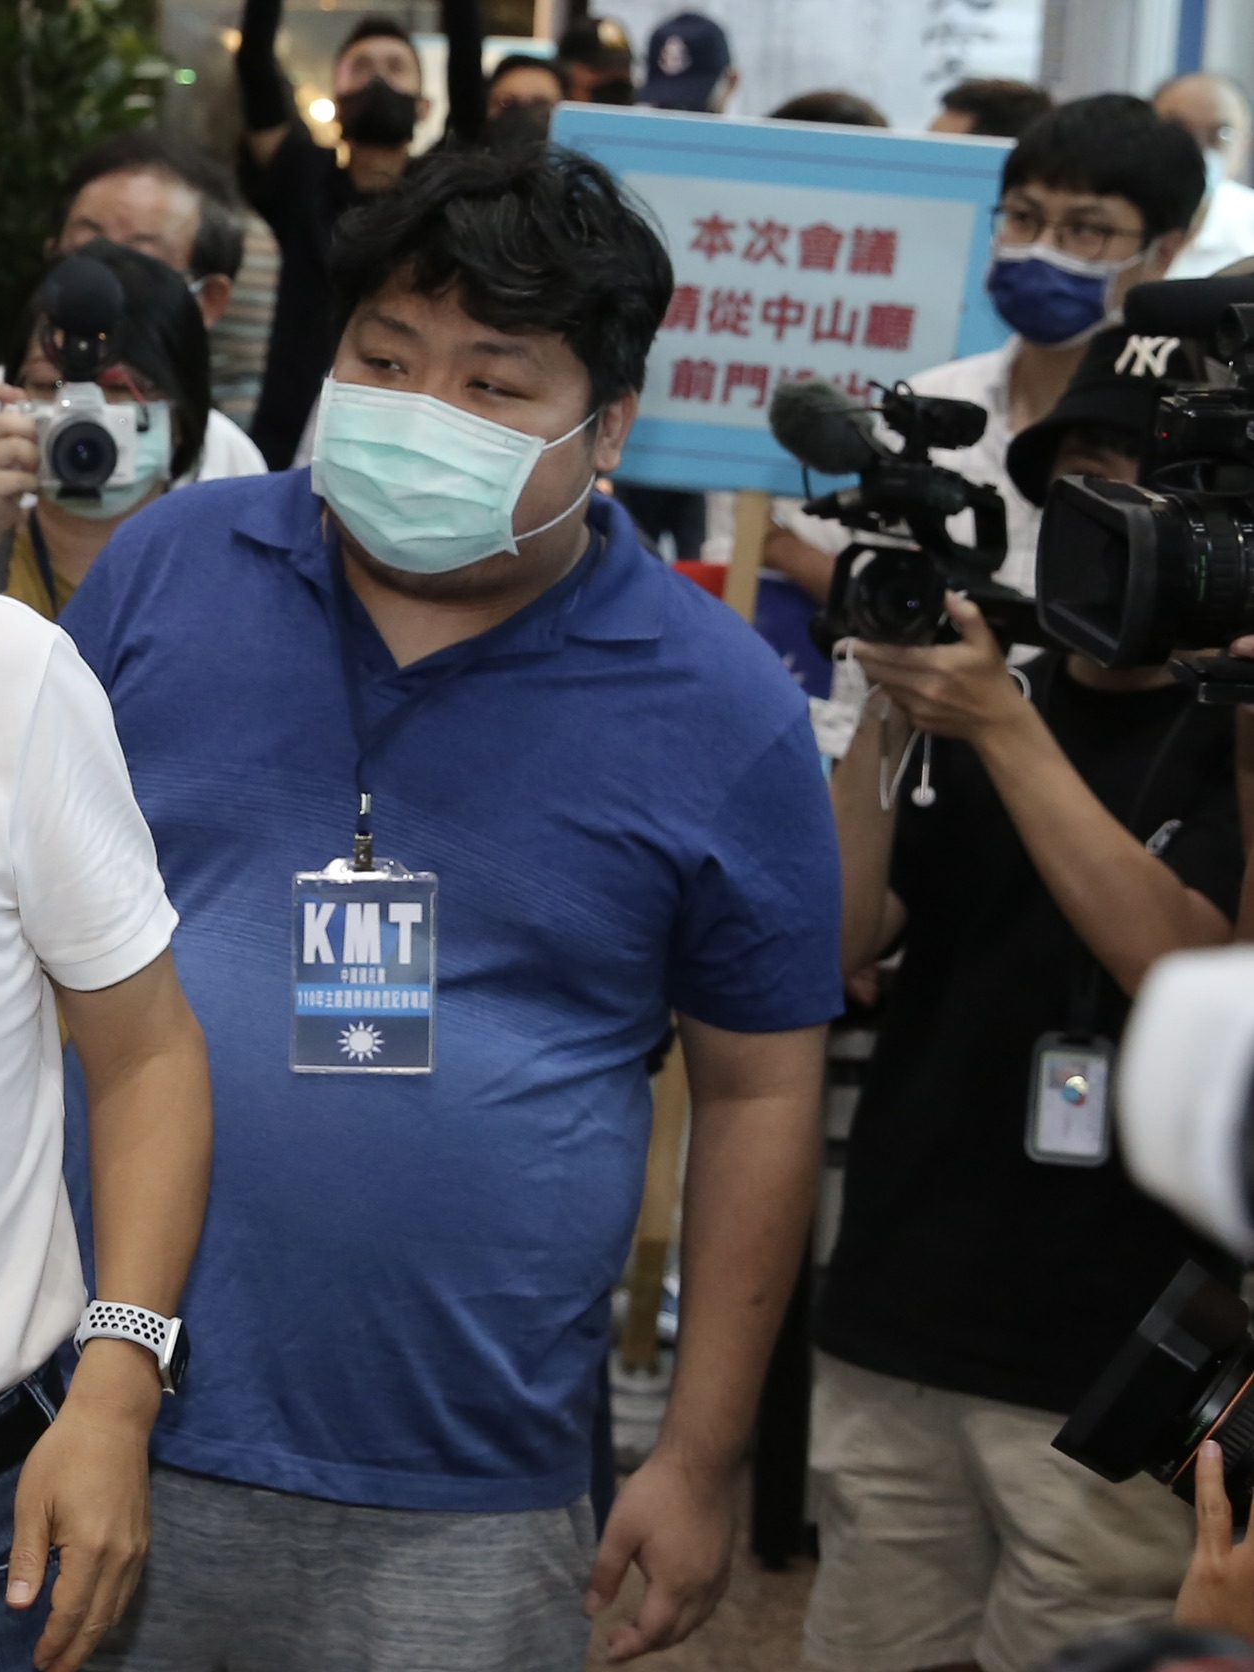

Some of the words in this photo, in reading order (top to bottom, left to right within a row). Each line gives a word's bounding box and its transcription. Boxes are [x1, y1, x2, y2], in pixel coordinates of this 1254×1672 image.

[689, 213, 898, 277] 本次會議
[302, 902, 423, 965] KMT
